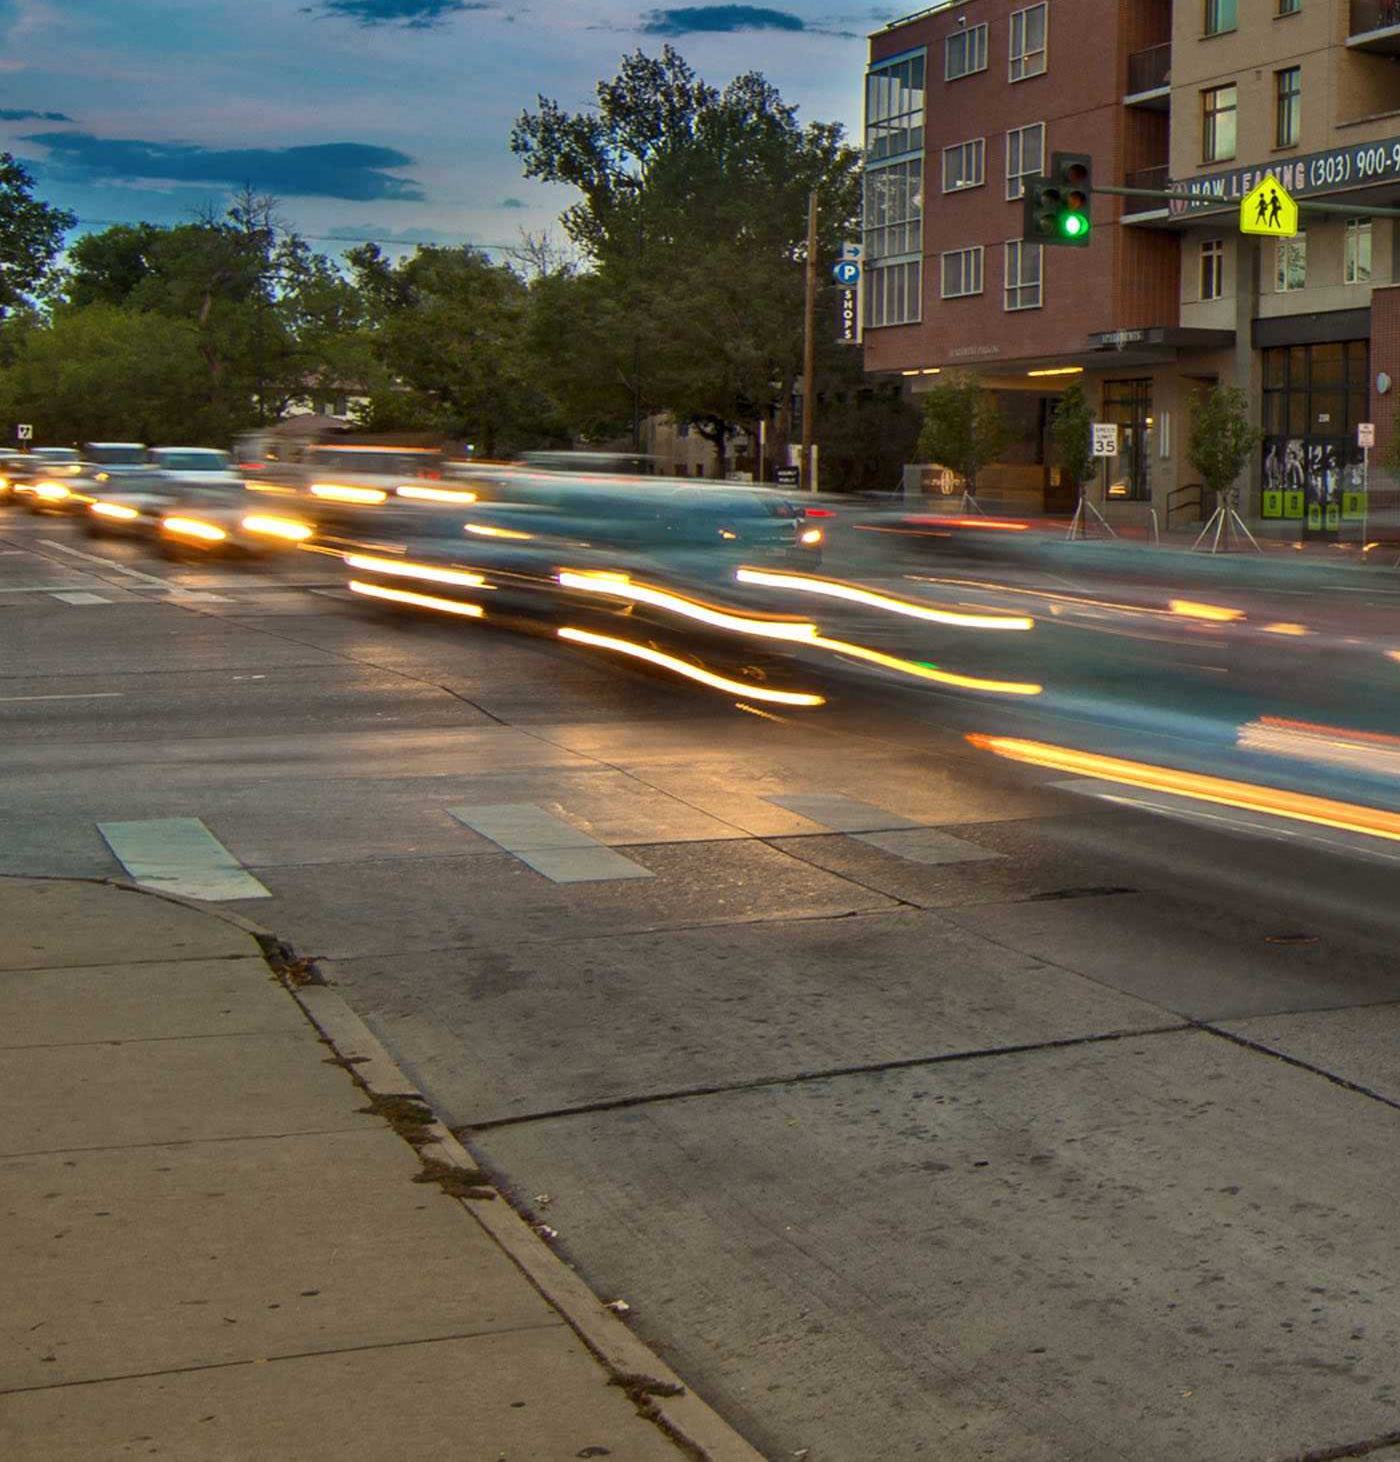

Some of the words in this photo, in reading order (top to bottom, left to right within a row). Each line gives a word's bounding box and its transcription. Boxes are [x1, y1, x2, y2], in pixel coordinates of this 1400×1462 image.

[1311, 153, 1350, 187] (303)
[844, 265, 856, 281] P
[843, 289, 854, 339] SHOPS
[1095, 440, 1116, 453] 35
